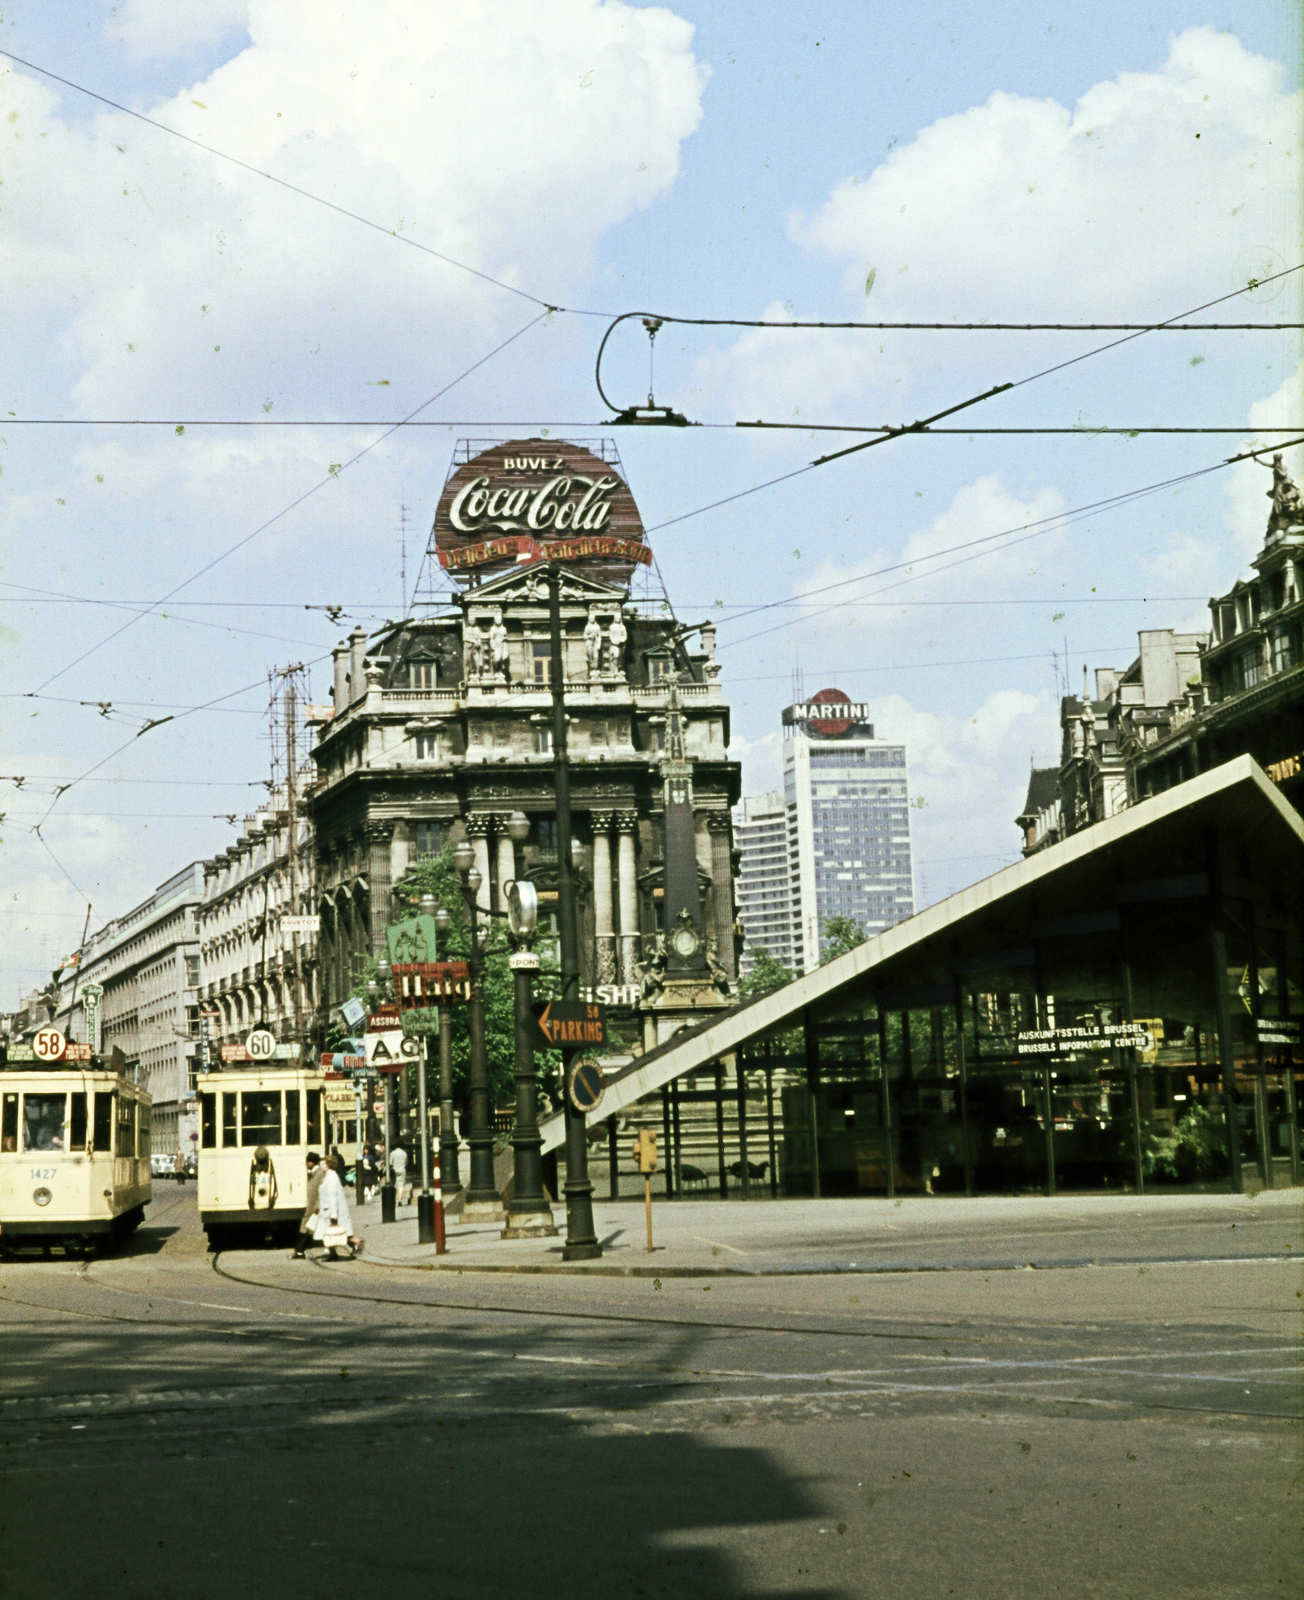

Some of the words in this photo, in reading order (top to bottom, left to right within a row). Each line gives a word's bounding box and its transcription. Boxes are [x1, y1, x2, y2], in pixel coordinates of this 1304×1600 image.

[504, 457, 564, 470] BUVEZ
[795, 705, 868, 718] MARTINI
[370, 1016, 402, 1027] ASSURA
[553, 1019, 603, 1042] PARKING
[1018, 1026, 1100, 1040] AUSKUNFTSSTELLE
[1104, 1024, 1144, 1035] BRUSSEL
[38, 1033, 60, 1056] 58
[251, 1034, 270, 1055] 60
[1018, 1043, 1056, 1054] BRUSSELS
[1114, 1037, 1146, 1048] CENTRE
[30, 1168, 57, 1180] 1427
